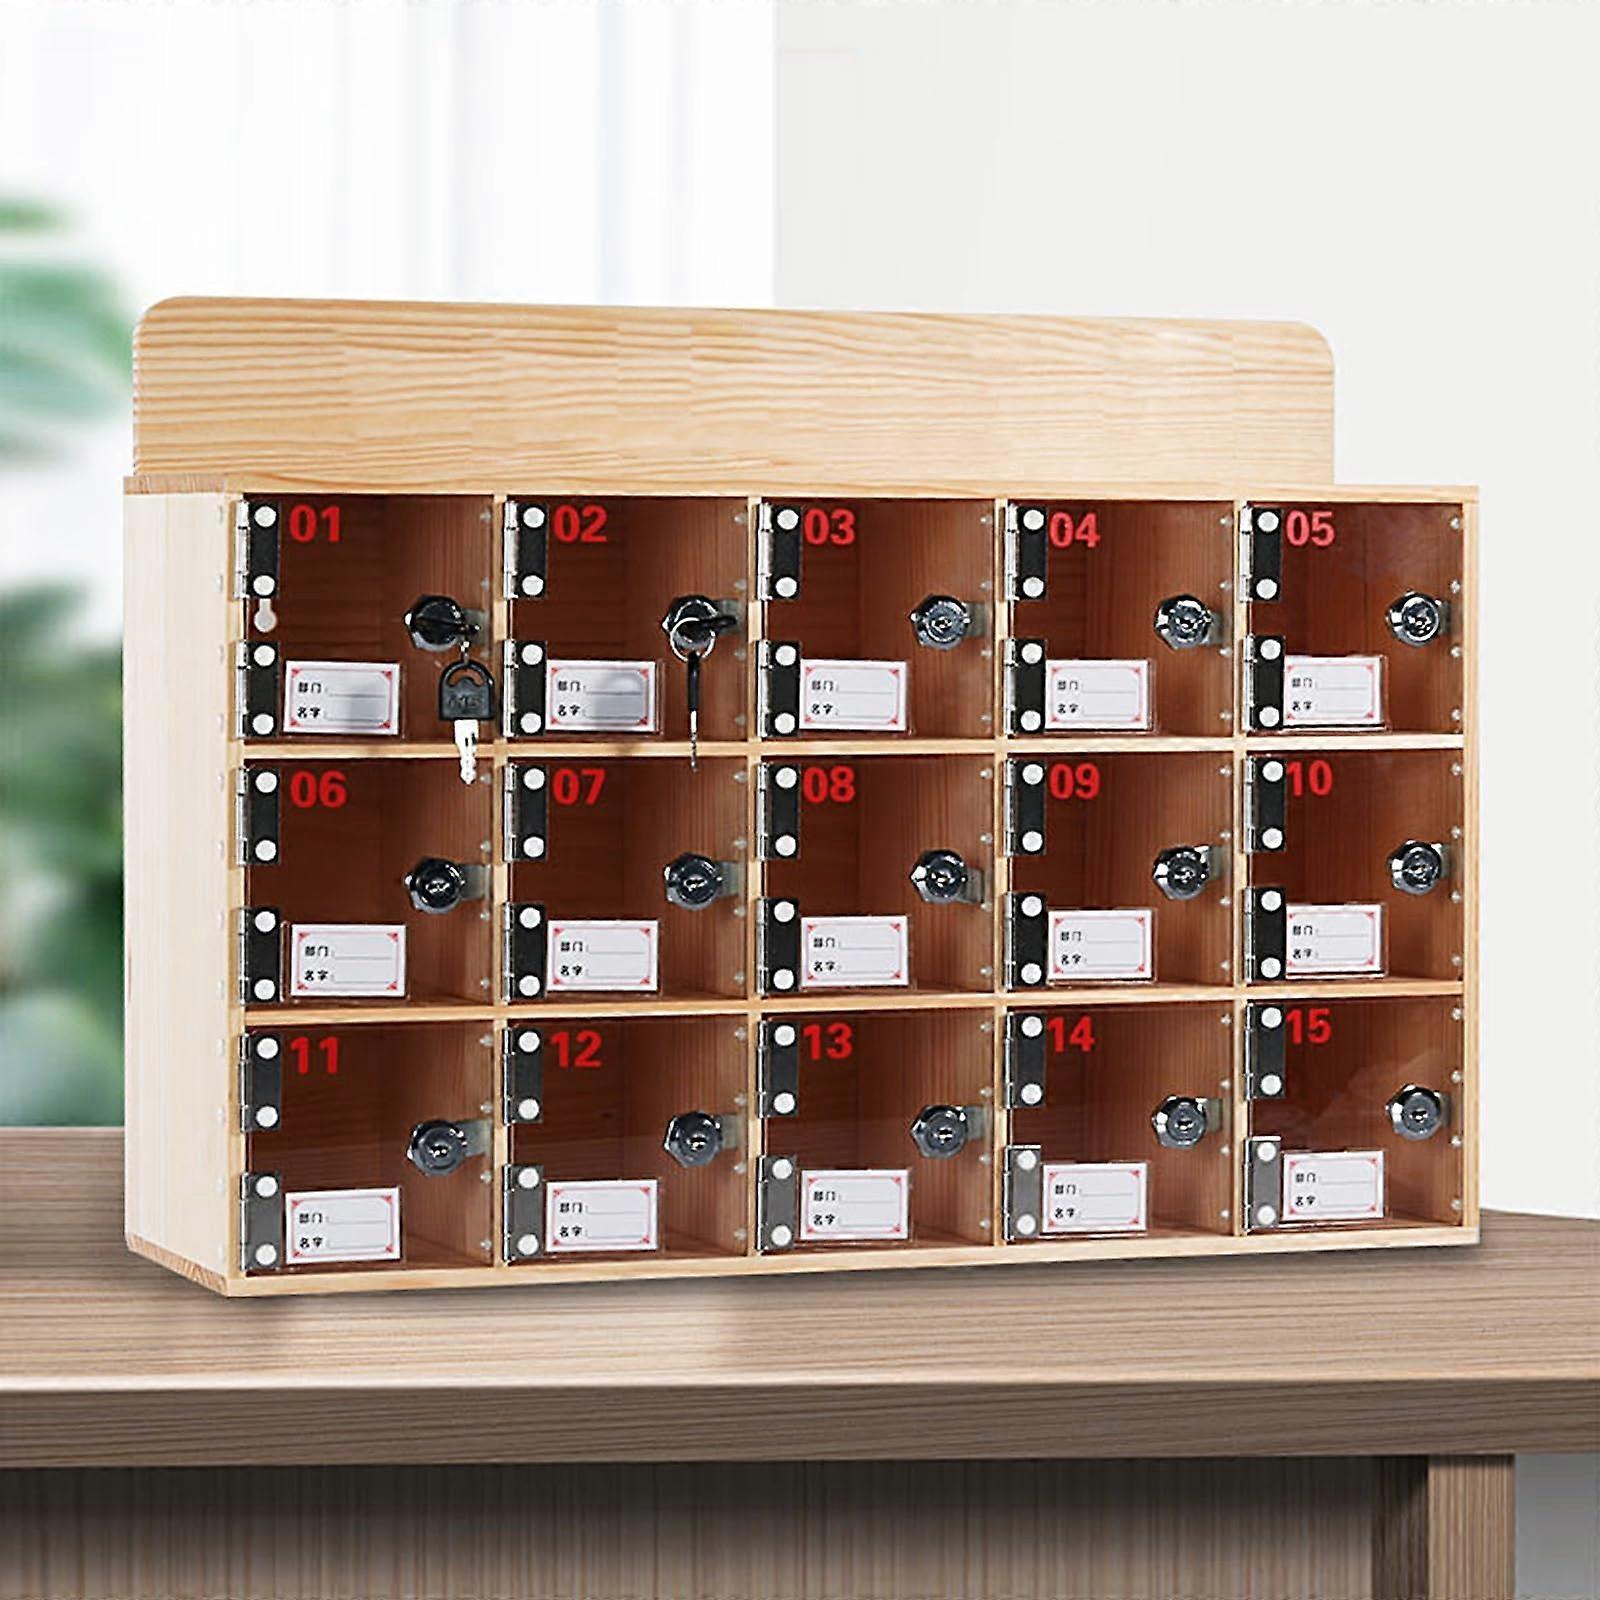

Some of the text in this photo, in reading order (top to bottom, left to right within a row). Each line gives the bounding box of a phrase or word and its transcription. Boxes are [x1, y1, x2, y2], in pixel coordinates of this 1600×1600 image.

[290, 505, 340, 542] 01
[554, 505, 607, 542] 02
[804, 508, 855, 546] 03
[1049, 512, 1101, 549] 04
[1286, 508, 1335, 547] 05
[291, 771, 346, 808] 06
[553, 768, 605, 805] 07
[803, 766, 855, 803] 08
[1050, 763, 1100, 800] 09
[1286, 759, 1333, 796] 10
[803, 1023, 852, 1060] 13
[1048, 1016, 1095, 1052] 14
[1286, 1008, 1331, 1044] 15
[291, 1037, 338, 1073] 11
[551, 1031, 605, 1067] 12
